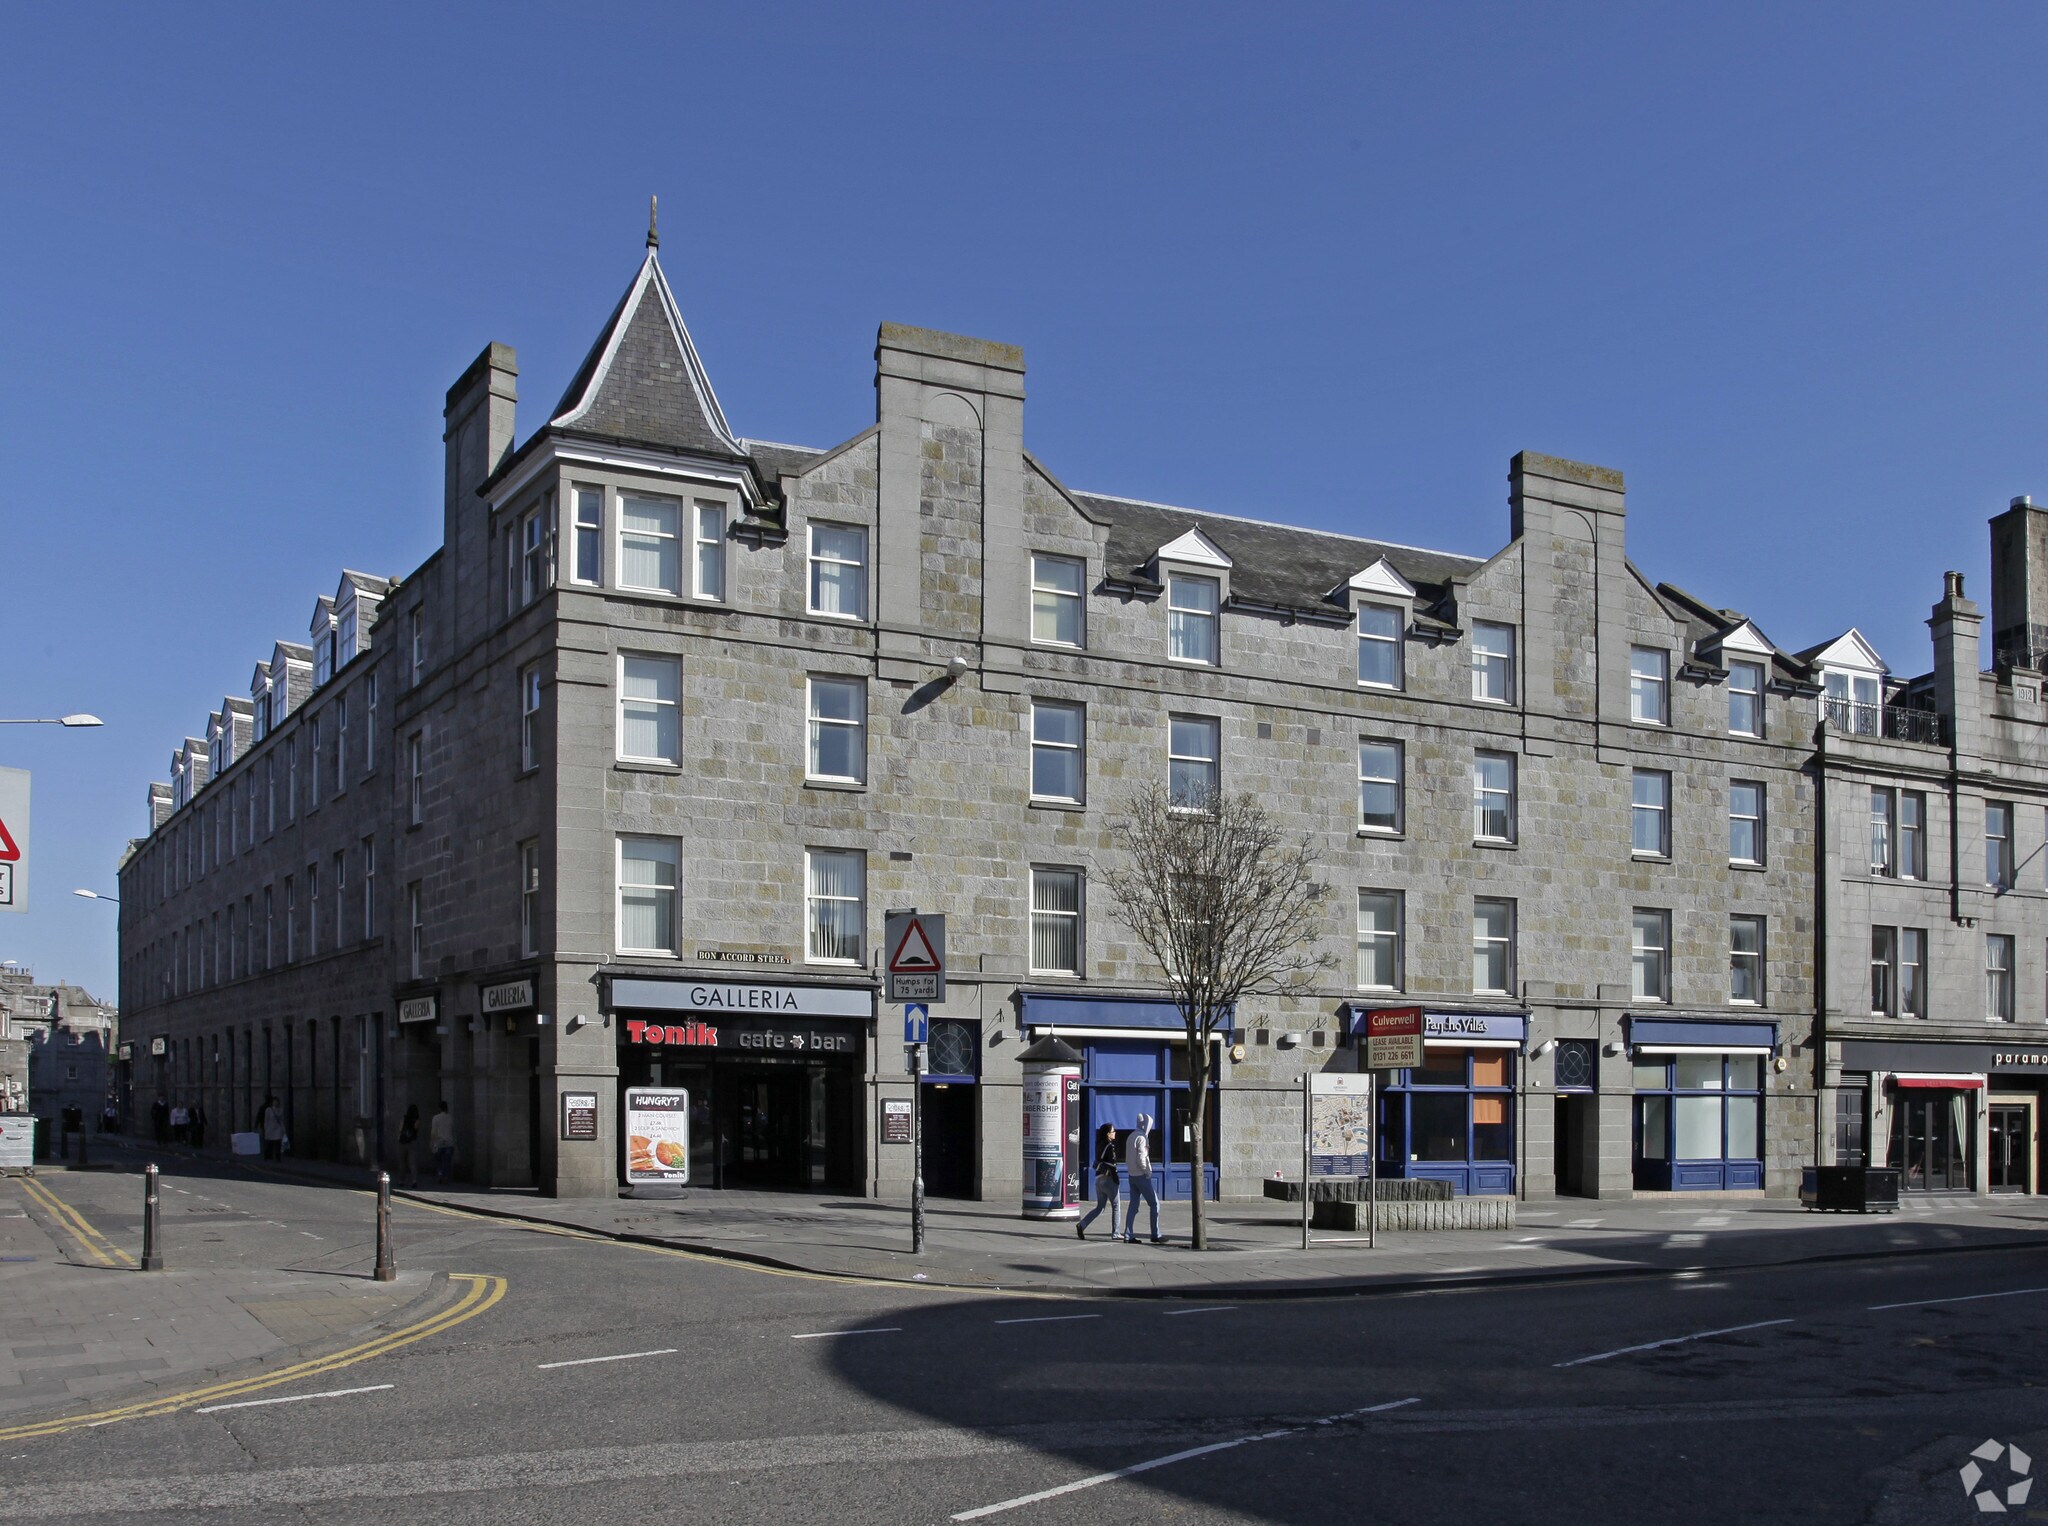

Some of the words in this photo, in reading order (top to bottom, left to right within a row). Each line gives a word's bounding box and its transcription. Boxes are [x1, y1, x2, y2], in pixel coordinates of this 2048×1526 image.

[2018, 688, 2032, 701] 1912
[699, 951, 717, 960] BON
[720, 952, 755, 962] ACCORD
[896, 977, 921, 986] Humps
[924, 977, 935, 985] for
[488, 984, 527, 1008] GALLERIA
[900, 986, 910, 994] 75
[914, 986, 935, 995] yards
[690, 986, 799, 1010] GALLERIA
[403, 1000, 431, 1020] GALLERIA
[1372, 1013, 1415, 1026] Culverwell
[626, 1018, 718, 1046] Tonik
[739, 1029, 786, 1049] cafe
[810, 1030, 847, 1050] bar
[1373, 1037, 1387, 1046] LEASE
[1388, 1035, 1414, 1045] AVAILABLE
[1373, 1052, 1386, 1061] 0131
[1387, 1051, 1399, 1060] 226
[1400, 1050, 1414, 1060] 6611
[635, 1095, 680, 1107] HUNGRY?
[663, 1171, 685, 1179] Tonik
